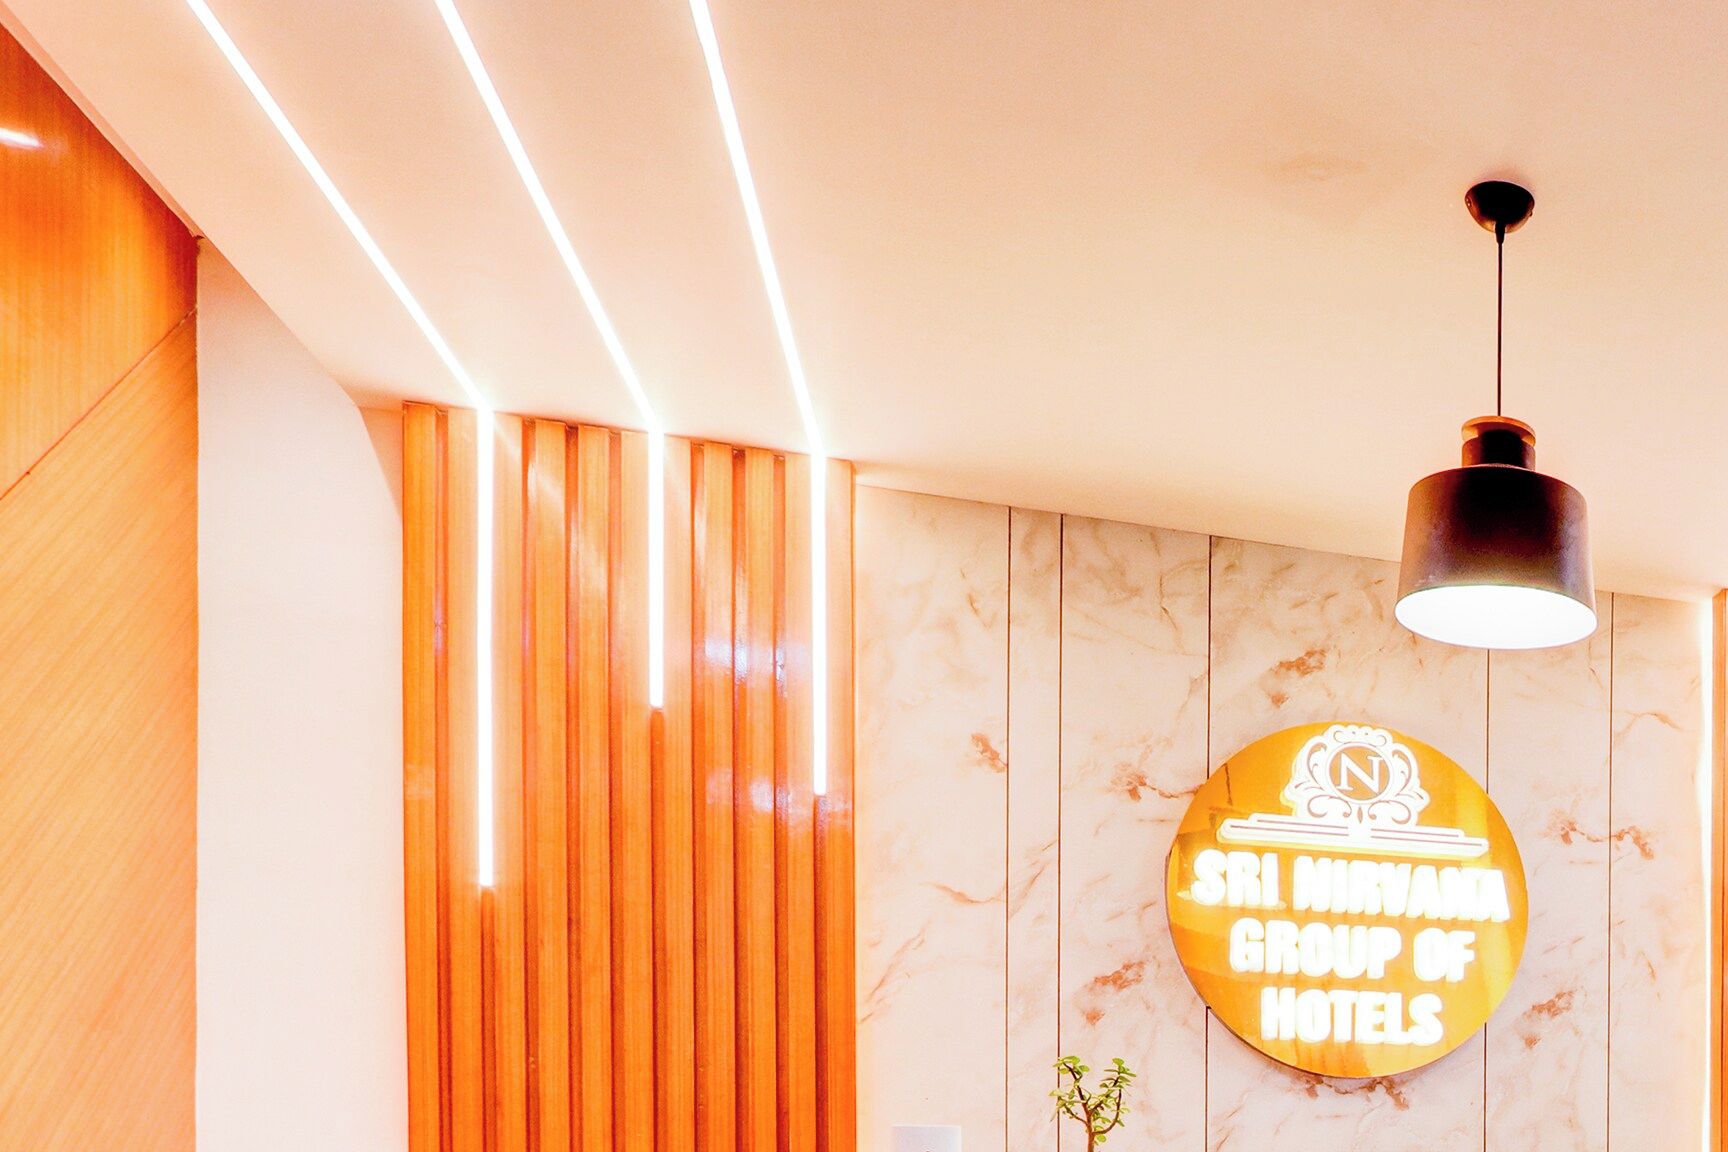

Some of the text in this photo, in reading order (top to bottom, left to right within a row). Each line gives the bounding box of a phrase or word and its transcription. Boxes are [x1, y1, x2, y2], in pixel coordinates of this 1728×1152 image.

[1335, 750, 1384, 796] N
[1192, 849, 1511, 922] SRI NIRVANA
[1229, 918, 1476, 982] GROUP OF
[1260, 986, 1443, 1046] HOTELS
